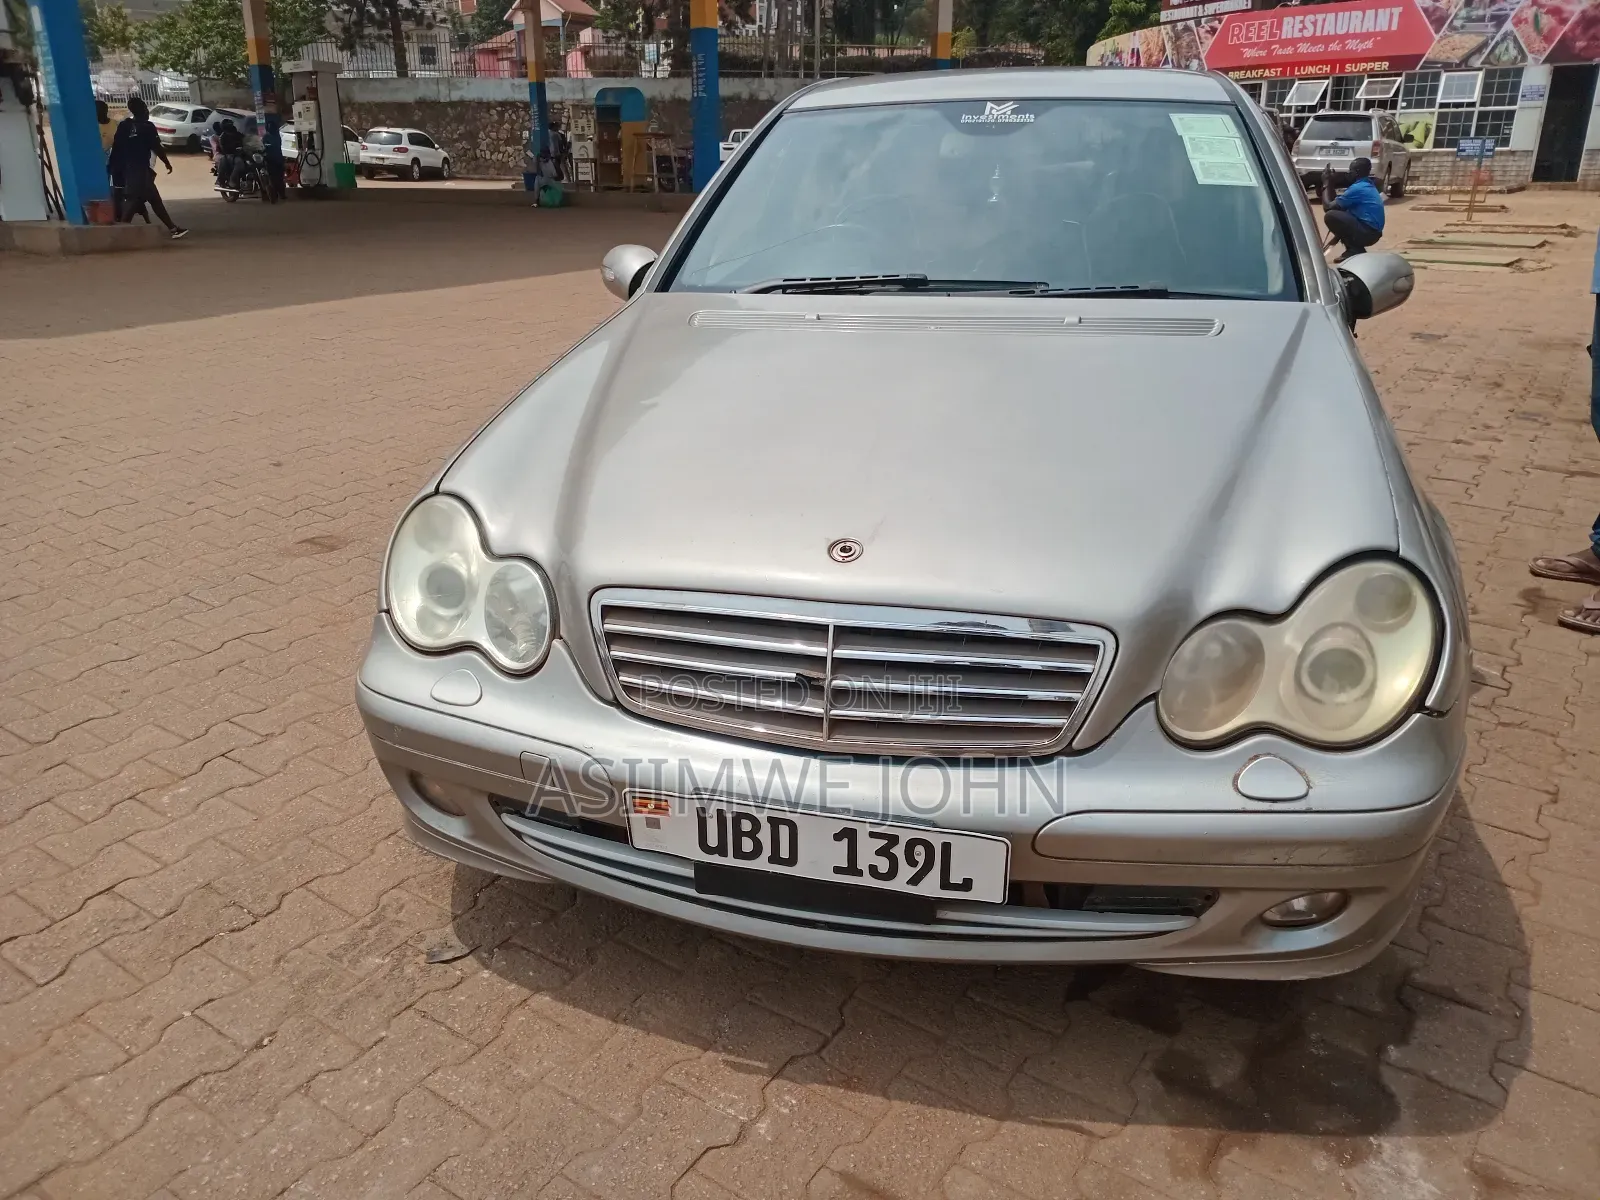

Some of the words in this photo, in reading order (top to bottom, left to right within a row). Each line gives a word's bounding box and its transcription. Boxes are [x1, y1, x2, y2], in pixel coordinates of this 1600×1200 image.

[1228, 19, 1280, 45] REEL
[1281, 7, 1402, 39] RESTAURANT
[1271, 44, 1295, 56] Taste
[1296, 41, 1325, 53] Meets
[1328, 40, 1342, 52] the
[1228, 67, 1282, 80] BREAKFAST
[1294, 65, 1331, 75] LUNCH
[1344, 61, 1389, 73] SUPPER
[696, 806, 799, 869] UBD
[832, 826, 973, 893] 139L
